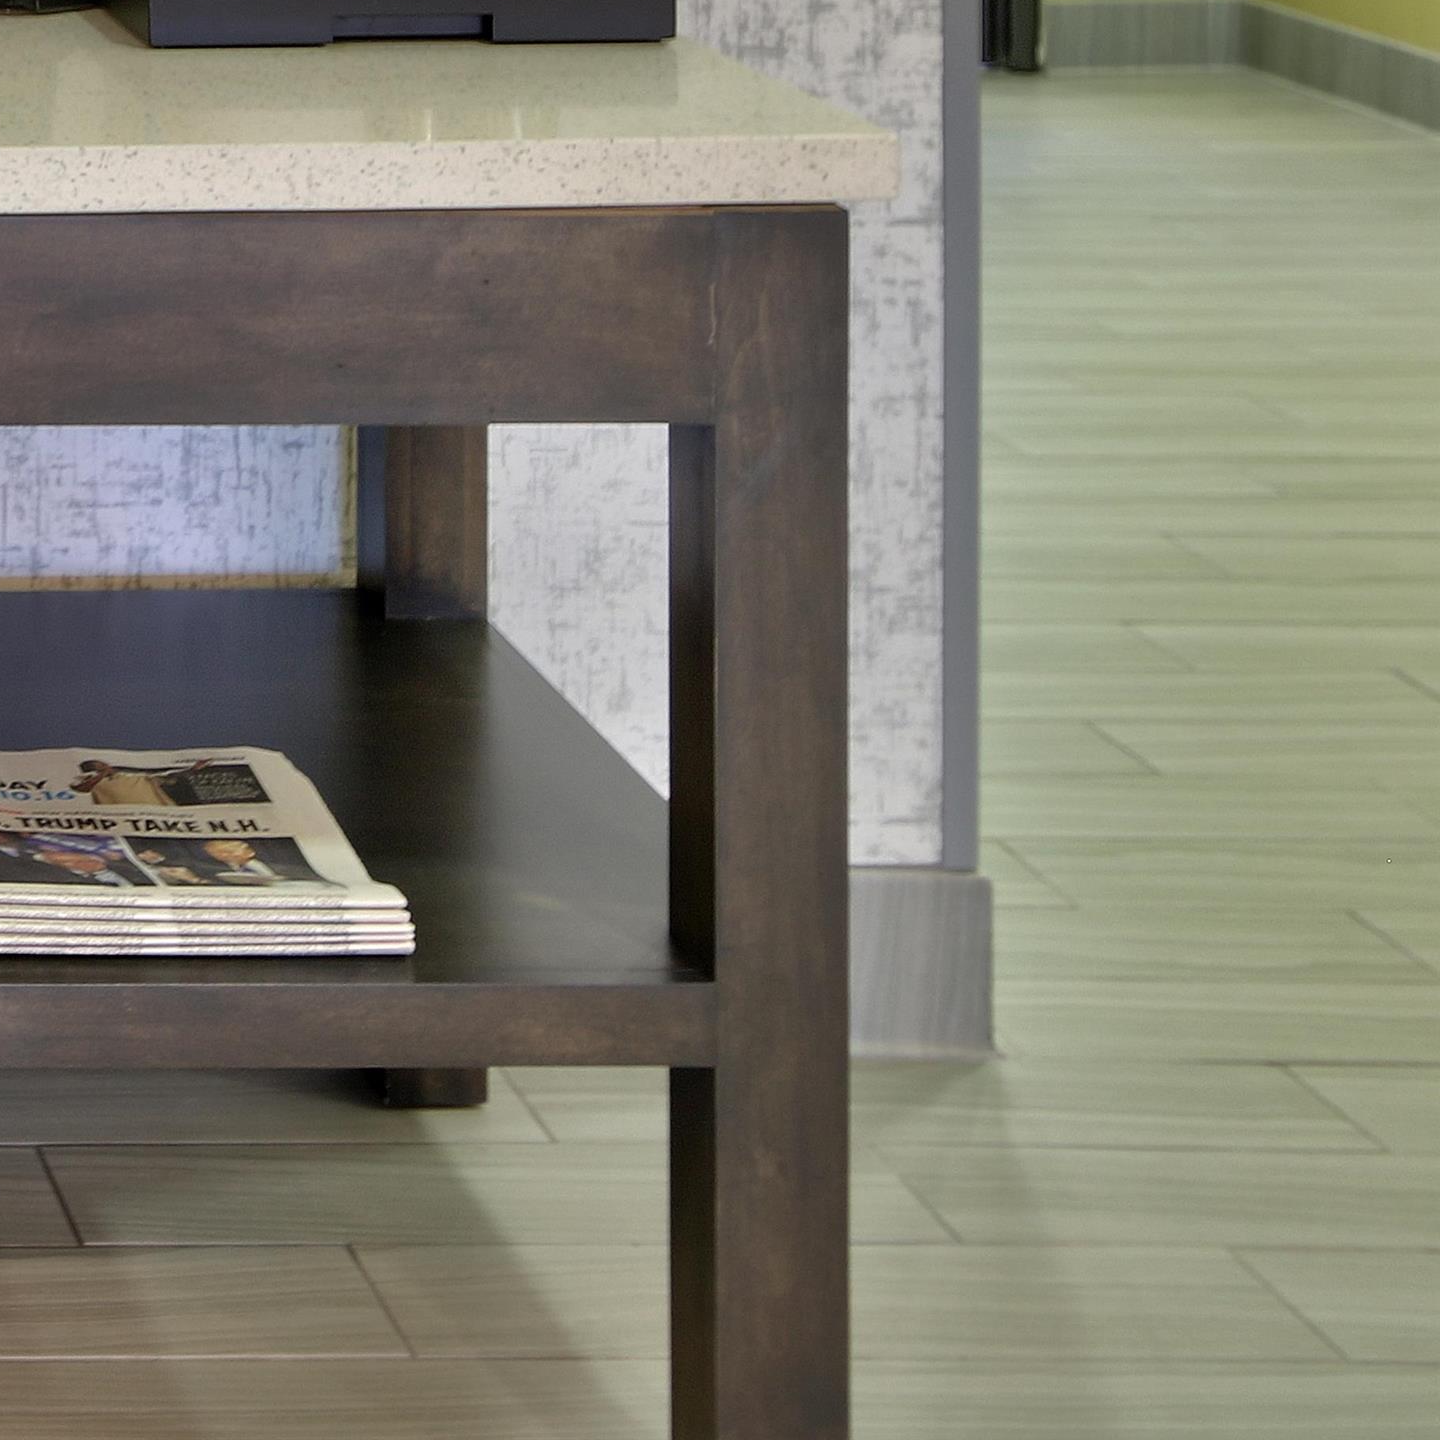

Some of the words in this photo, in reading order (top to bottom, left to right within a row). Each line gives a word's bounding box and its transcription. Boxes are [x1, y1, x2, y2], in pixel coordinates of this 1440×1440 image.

[15, 816, 118, 831] TRUMP
[125, 818, 201, 833] TAKE
[208, 819, 270, 833] N.H.
